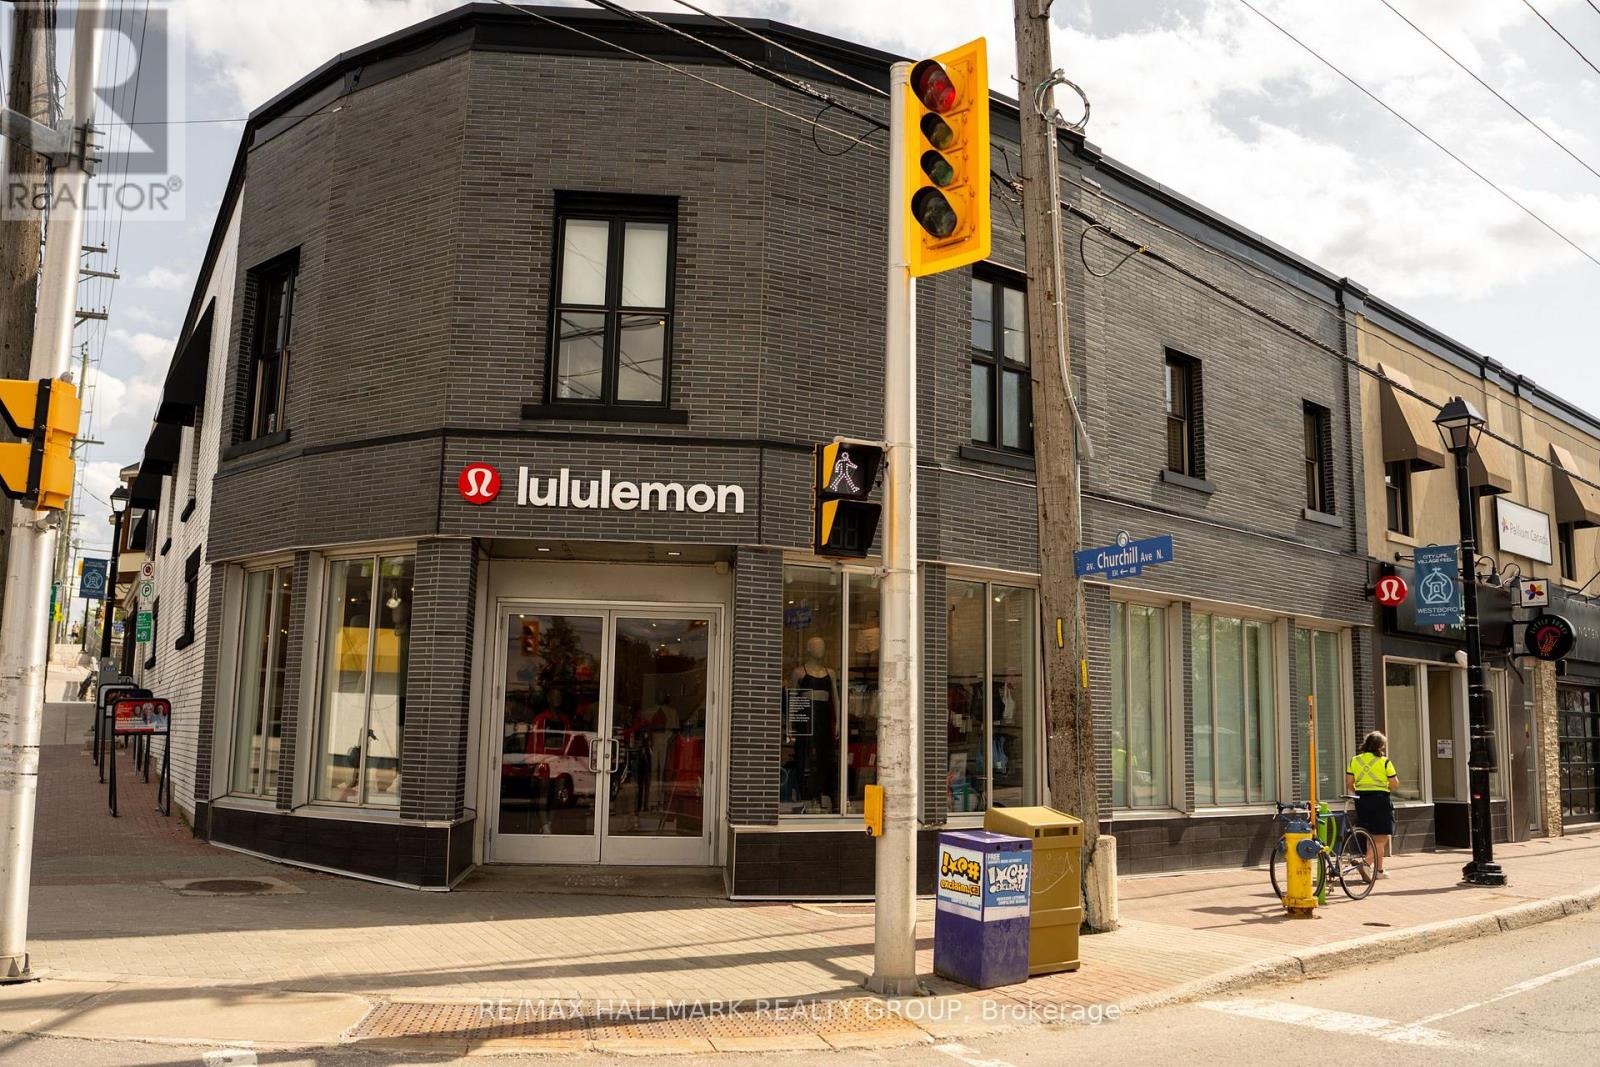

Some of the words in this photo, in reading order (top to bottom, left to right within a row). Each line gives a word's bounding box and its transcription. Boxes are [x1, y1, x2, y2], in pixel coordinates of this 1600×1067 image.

[517, 466, 745, 513] lululemon
[1097, 546, 1138, 568] Churchill
[1141, 552, 1153, 562] Ave
[1417, 606, 1459, 614] WESTBORO
